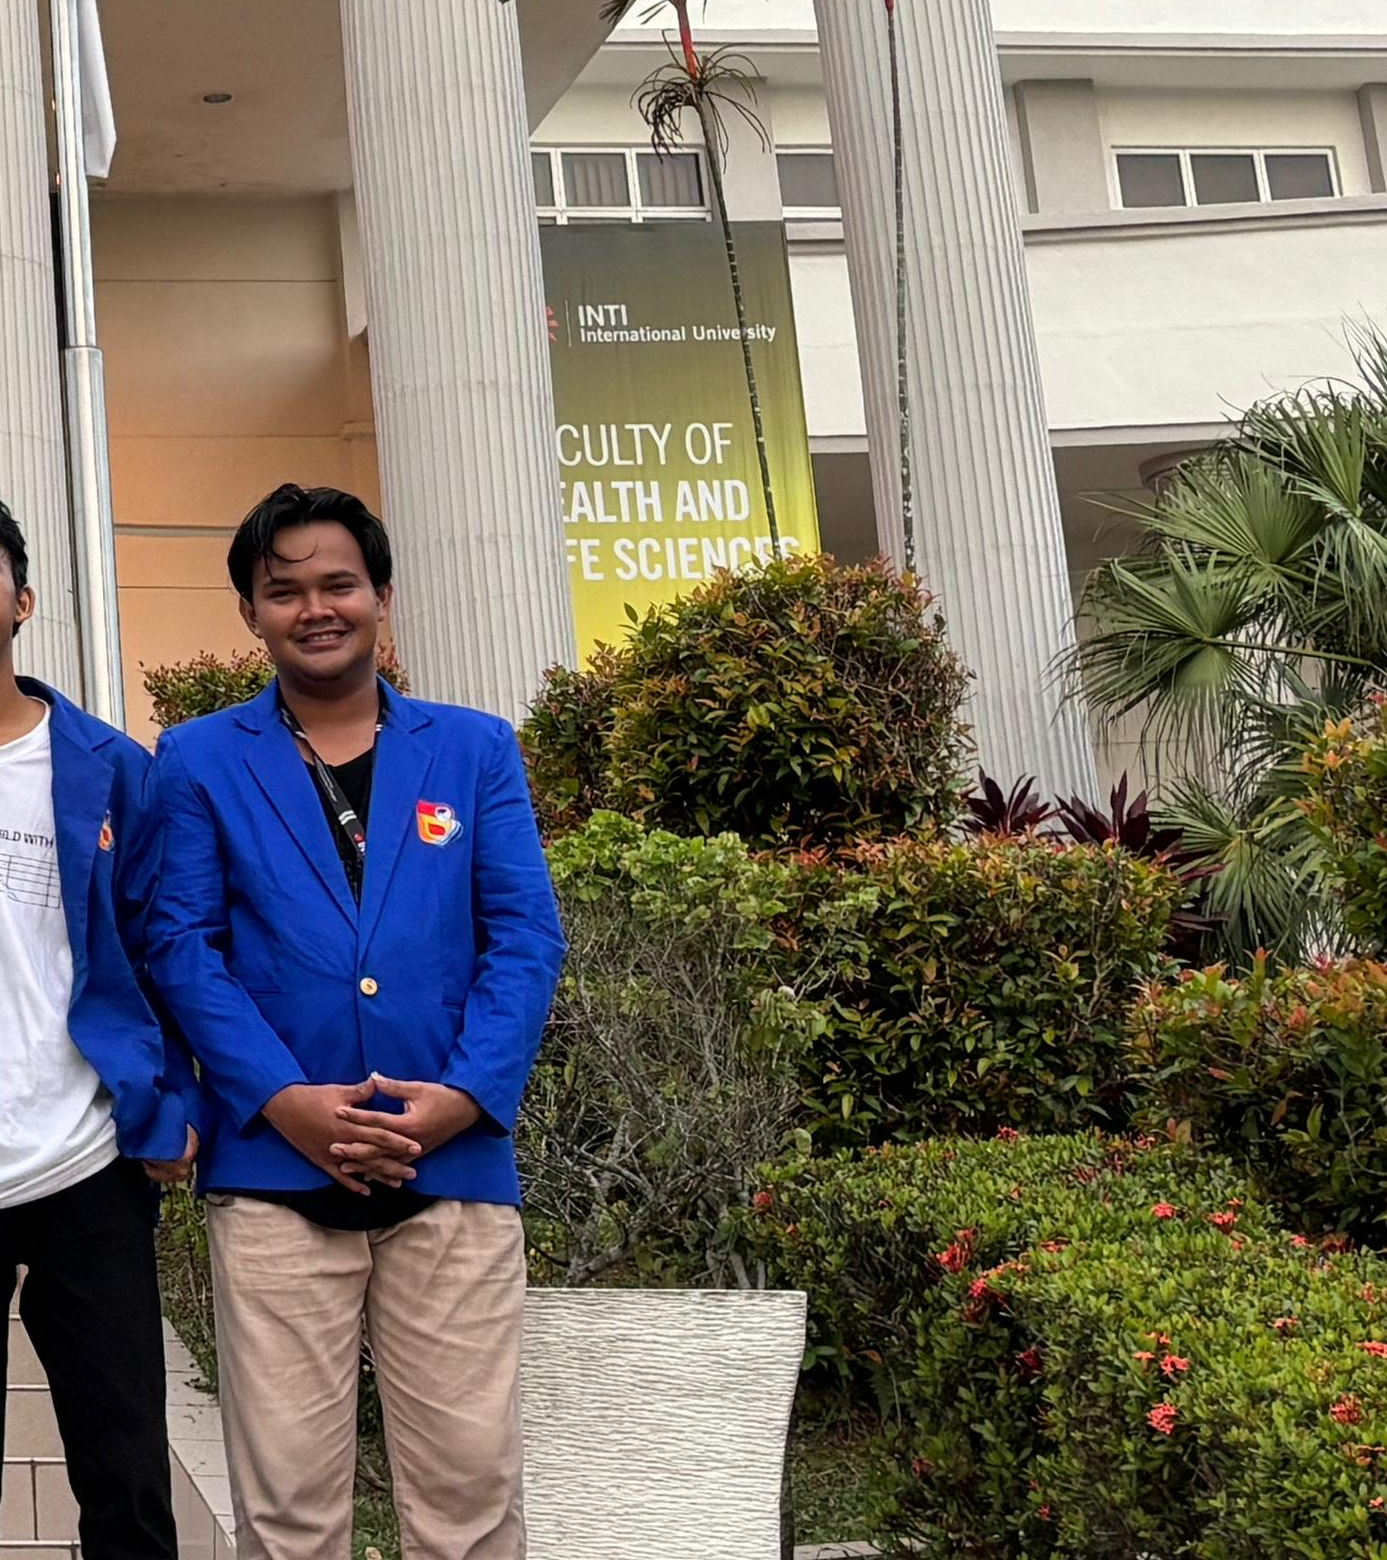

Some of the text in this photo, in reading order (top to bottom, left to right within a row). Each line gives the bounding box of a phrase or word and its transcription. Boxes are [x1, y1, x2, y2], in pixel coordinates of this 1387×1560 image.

[578, 305, 628, 326] INTI
[580, 326, 686, 342] International
[555, 422, 733, 466] CULTY OF
[558, 480, 750, 523] ALTH AND
[24, 833, 54, 848] WITH
